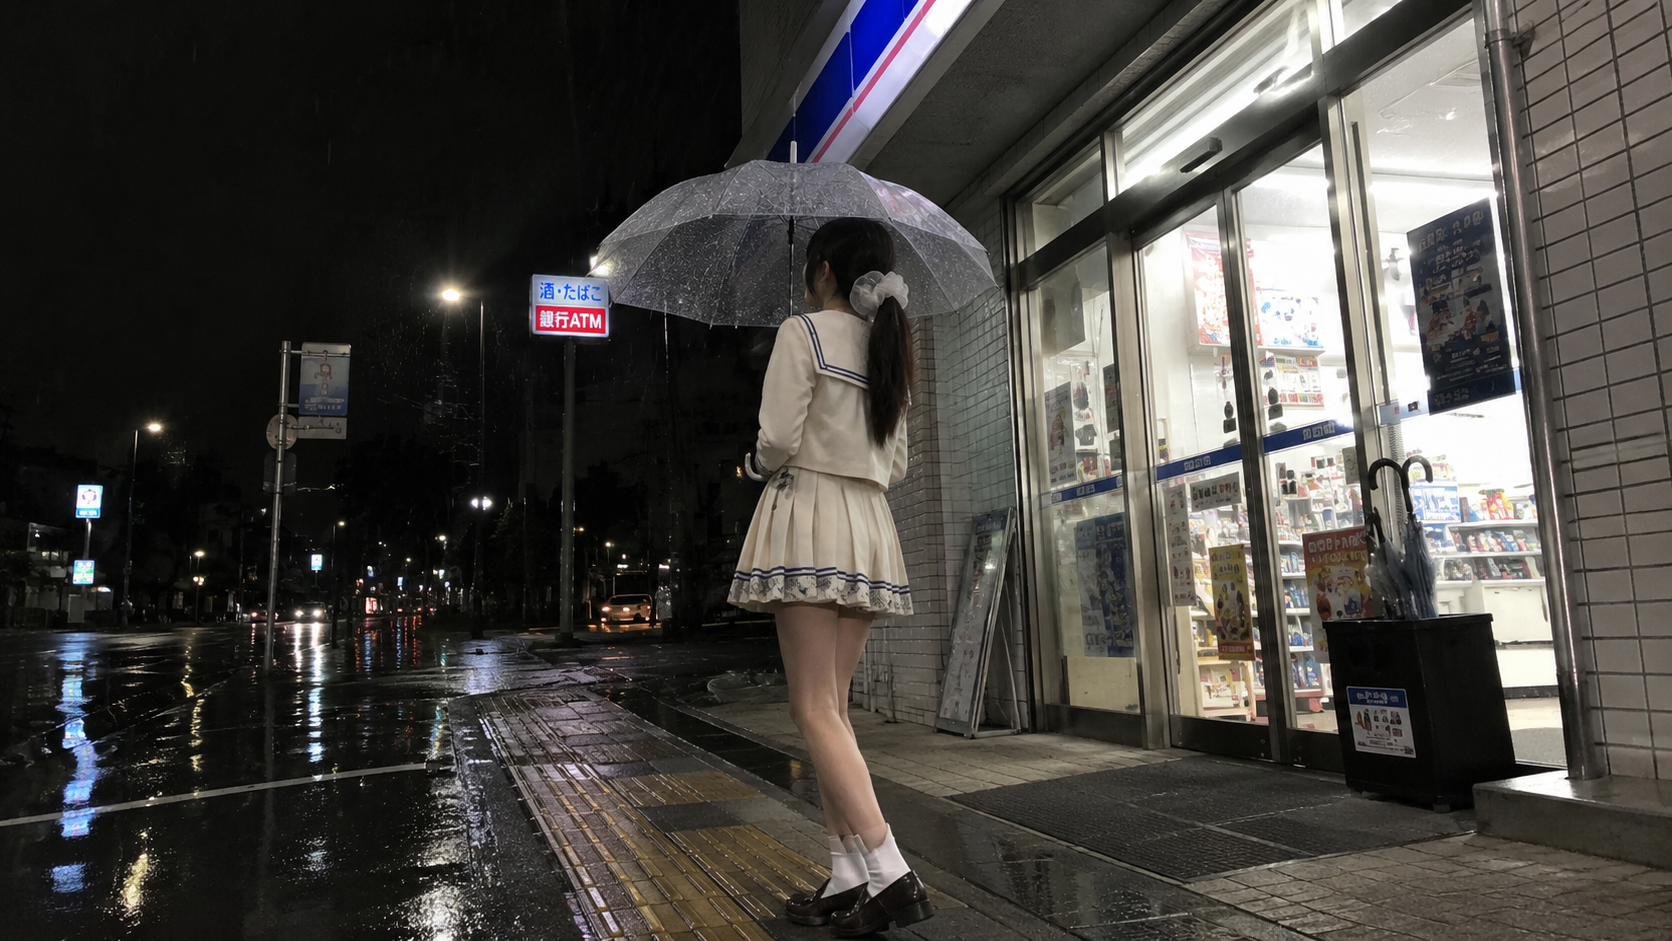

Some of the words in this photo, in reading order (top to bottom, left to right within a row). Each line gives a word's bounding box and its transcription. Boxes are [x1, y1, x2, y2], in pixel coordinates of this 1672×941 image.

[540, 282, 602, 302] 酒・たばこ
[539, 310, 602, 329] 銀行ATM
